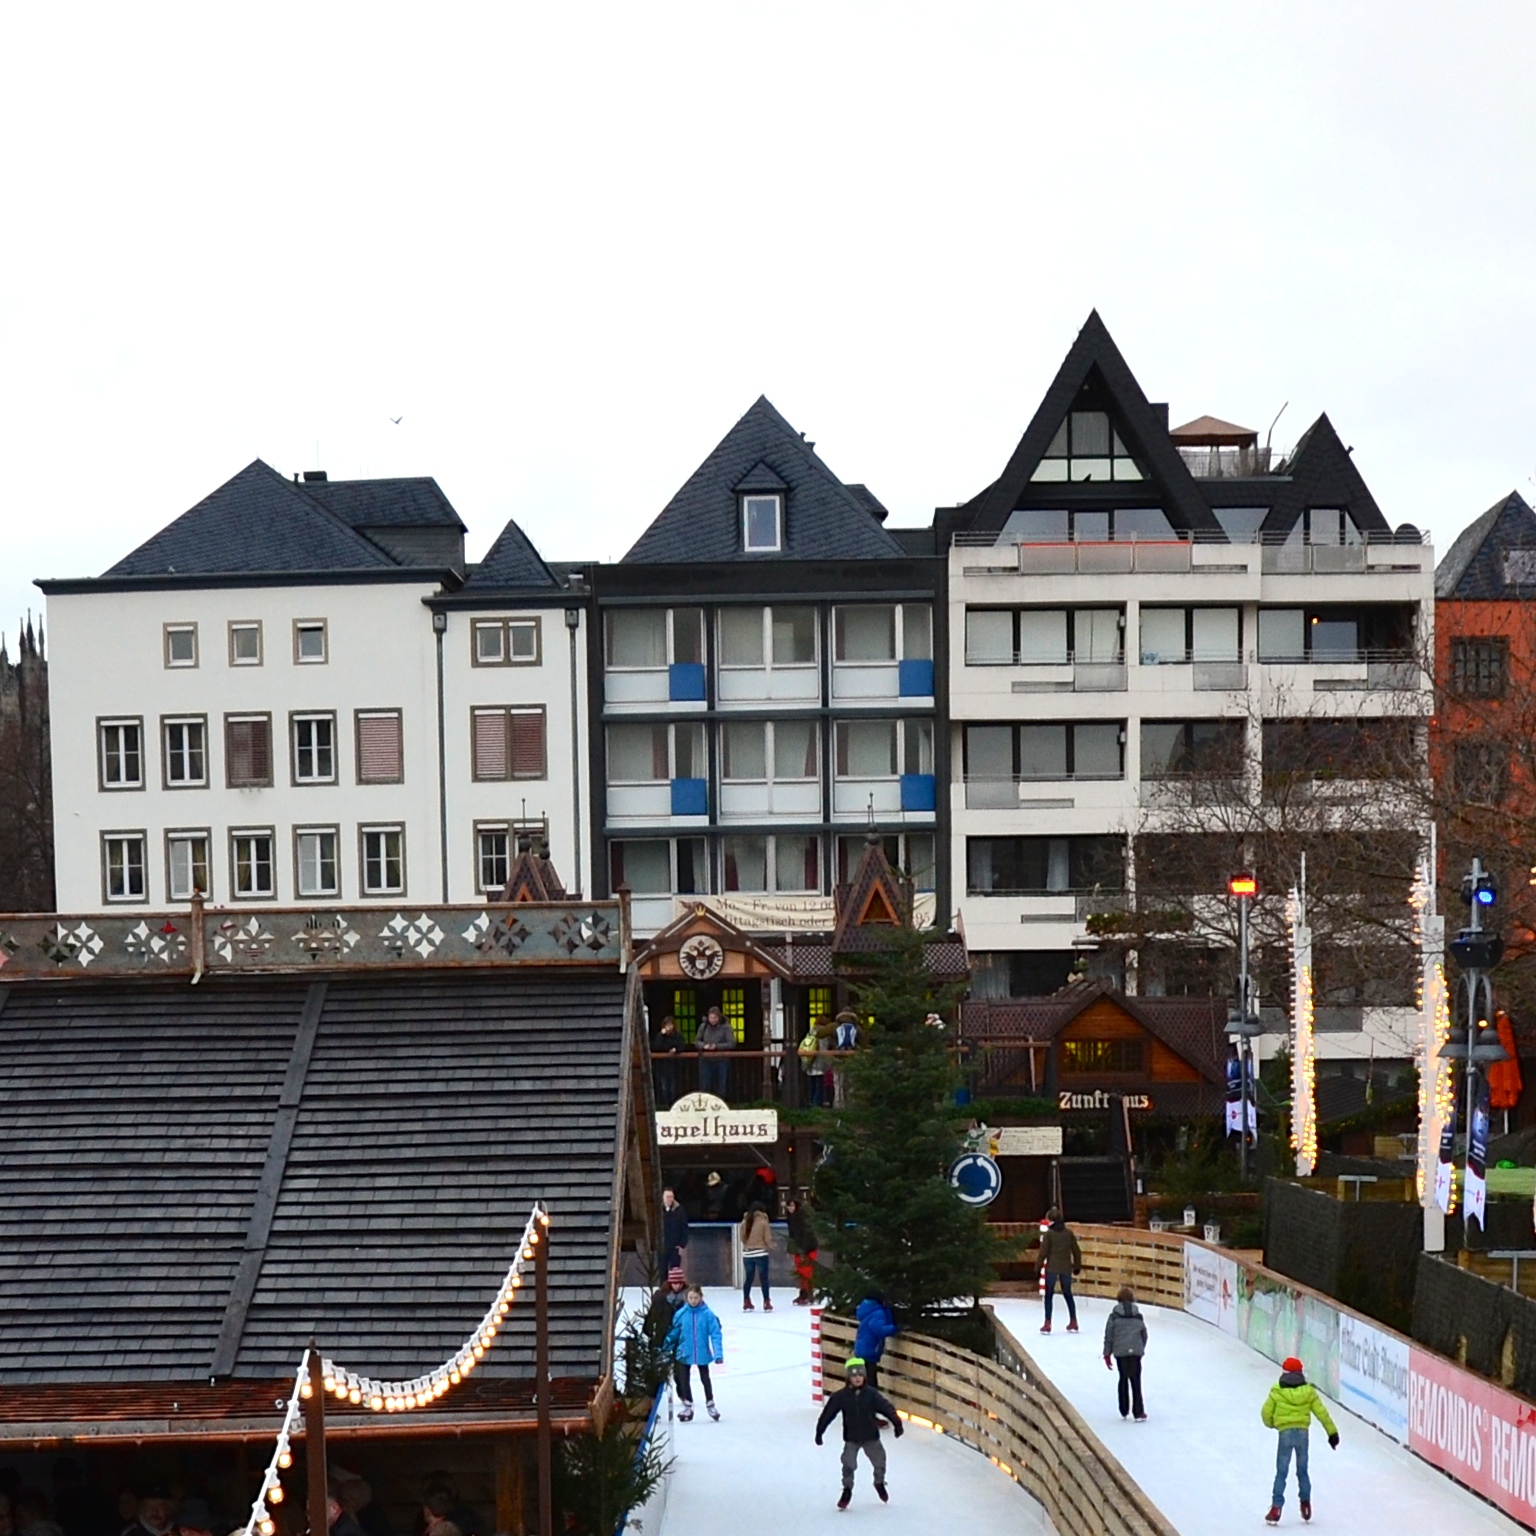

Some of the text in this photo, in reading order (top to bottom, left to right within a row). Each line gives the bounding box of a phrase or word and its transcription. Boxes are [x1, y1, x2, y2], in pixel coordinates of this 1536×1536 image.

[716, 899, 740, 911] Mo.
[752, 899, 771, 911] Fr.
[775, 902, 798, 912] von
[799, 915, 827, 926] oder
[1059, 1089, 1149, 1109] Zunftus
[659, 1116, 768, 1142] apelhaus
